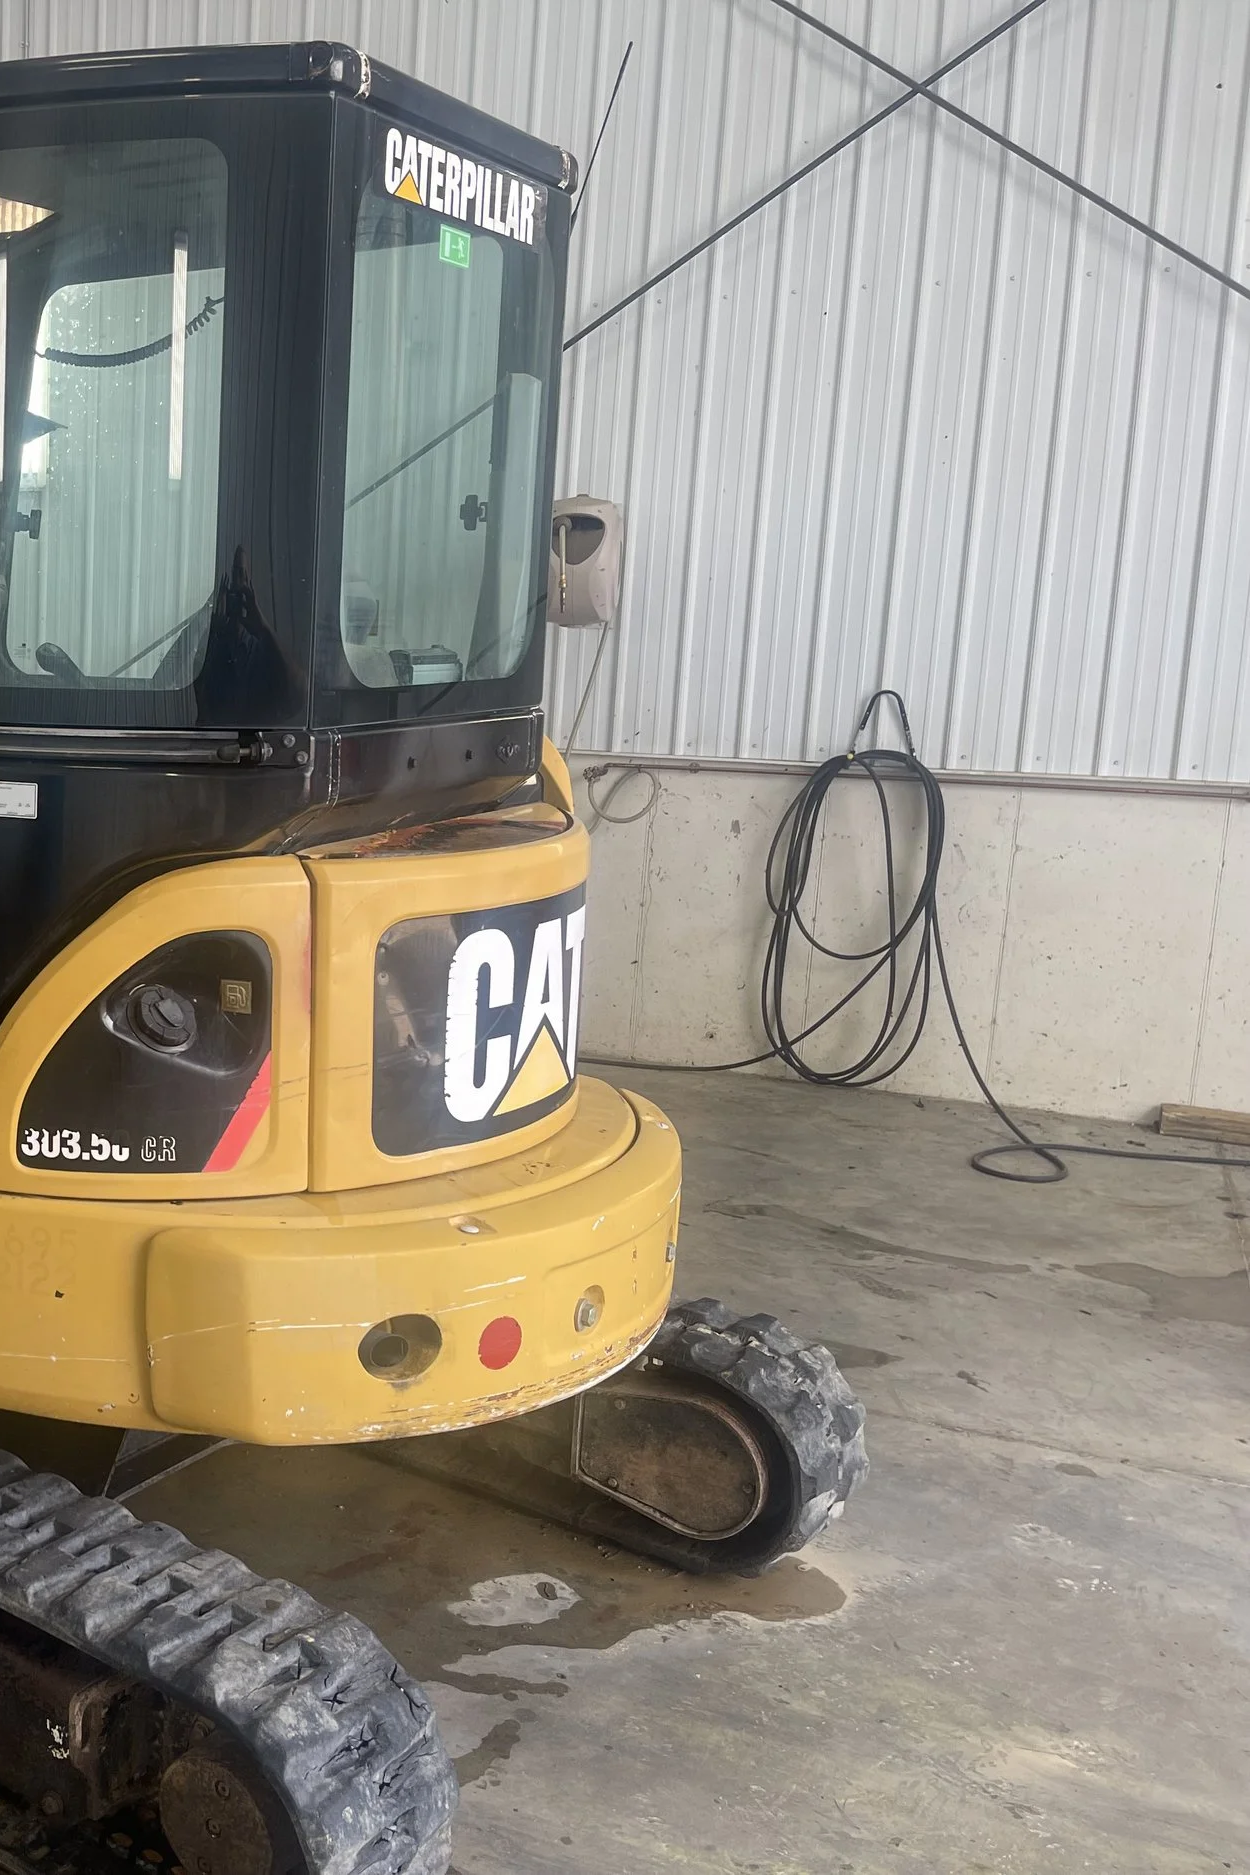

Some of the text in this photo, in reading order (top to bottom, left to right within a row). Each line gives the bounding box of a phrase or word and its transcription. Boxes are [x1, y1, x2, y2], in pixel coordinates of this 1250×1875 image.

[385, 127, 536, 246] CATERPILLAR
[444, 904, 586, 1123] CAT
[141, 1135, 177, 1162] CR
